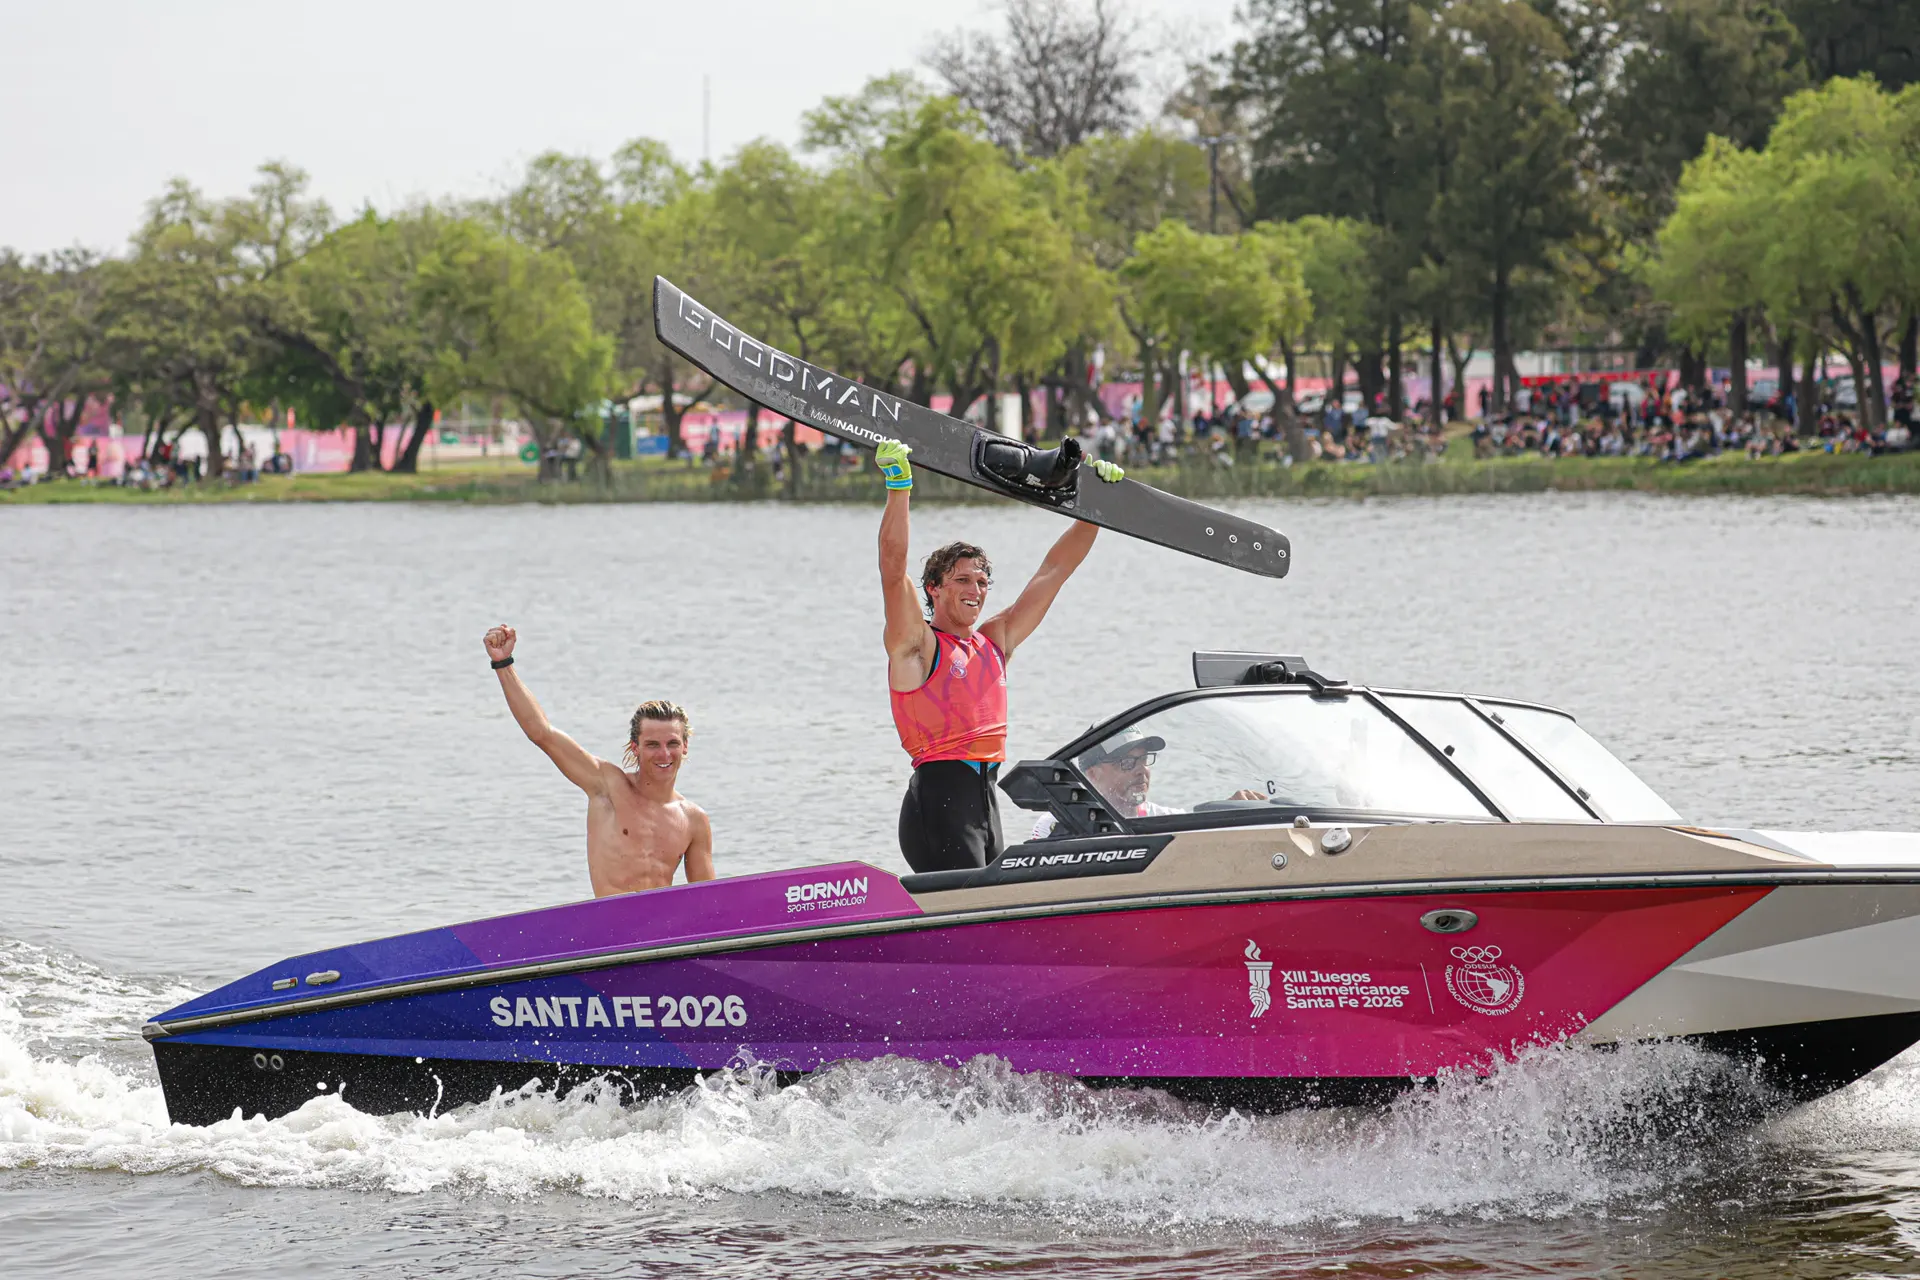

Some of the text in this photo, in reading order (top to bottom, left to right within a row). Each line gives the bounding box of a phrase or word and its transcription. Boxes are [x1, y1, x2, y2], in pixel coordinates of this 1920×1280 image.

[810, 407, 894, 444] MIAMINAUTIQ
[1000, 848, 1149, 870] SKI NAUTIQUE
[785, 876, 868, 903] BORNAN
[787, 895, 868, 914] SPORTS TECHNOLOGY
[1280, 970, 1372, 986] XIII Juegos
[1283, 982, 1410, 996] Suramericanos
[1472, 1005, 1510, 1016] DEPORTIVA
[1508, 963, 1525, 1011] SURAMERICANA
[489, 994, 748, 1028] SANTA FE 2026
[1286, 995, 1404, 1009] Santa Fe 2026
